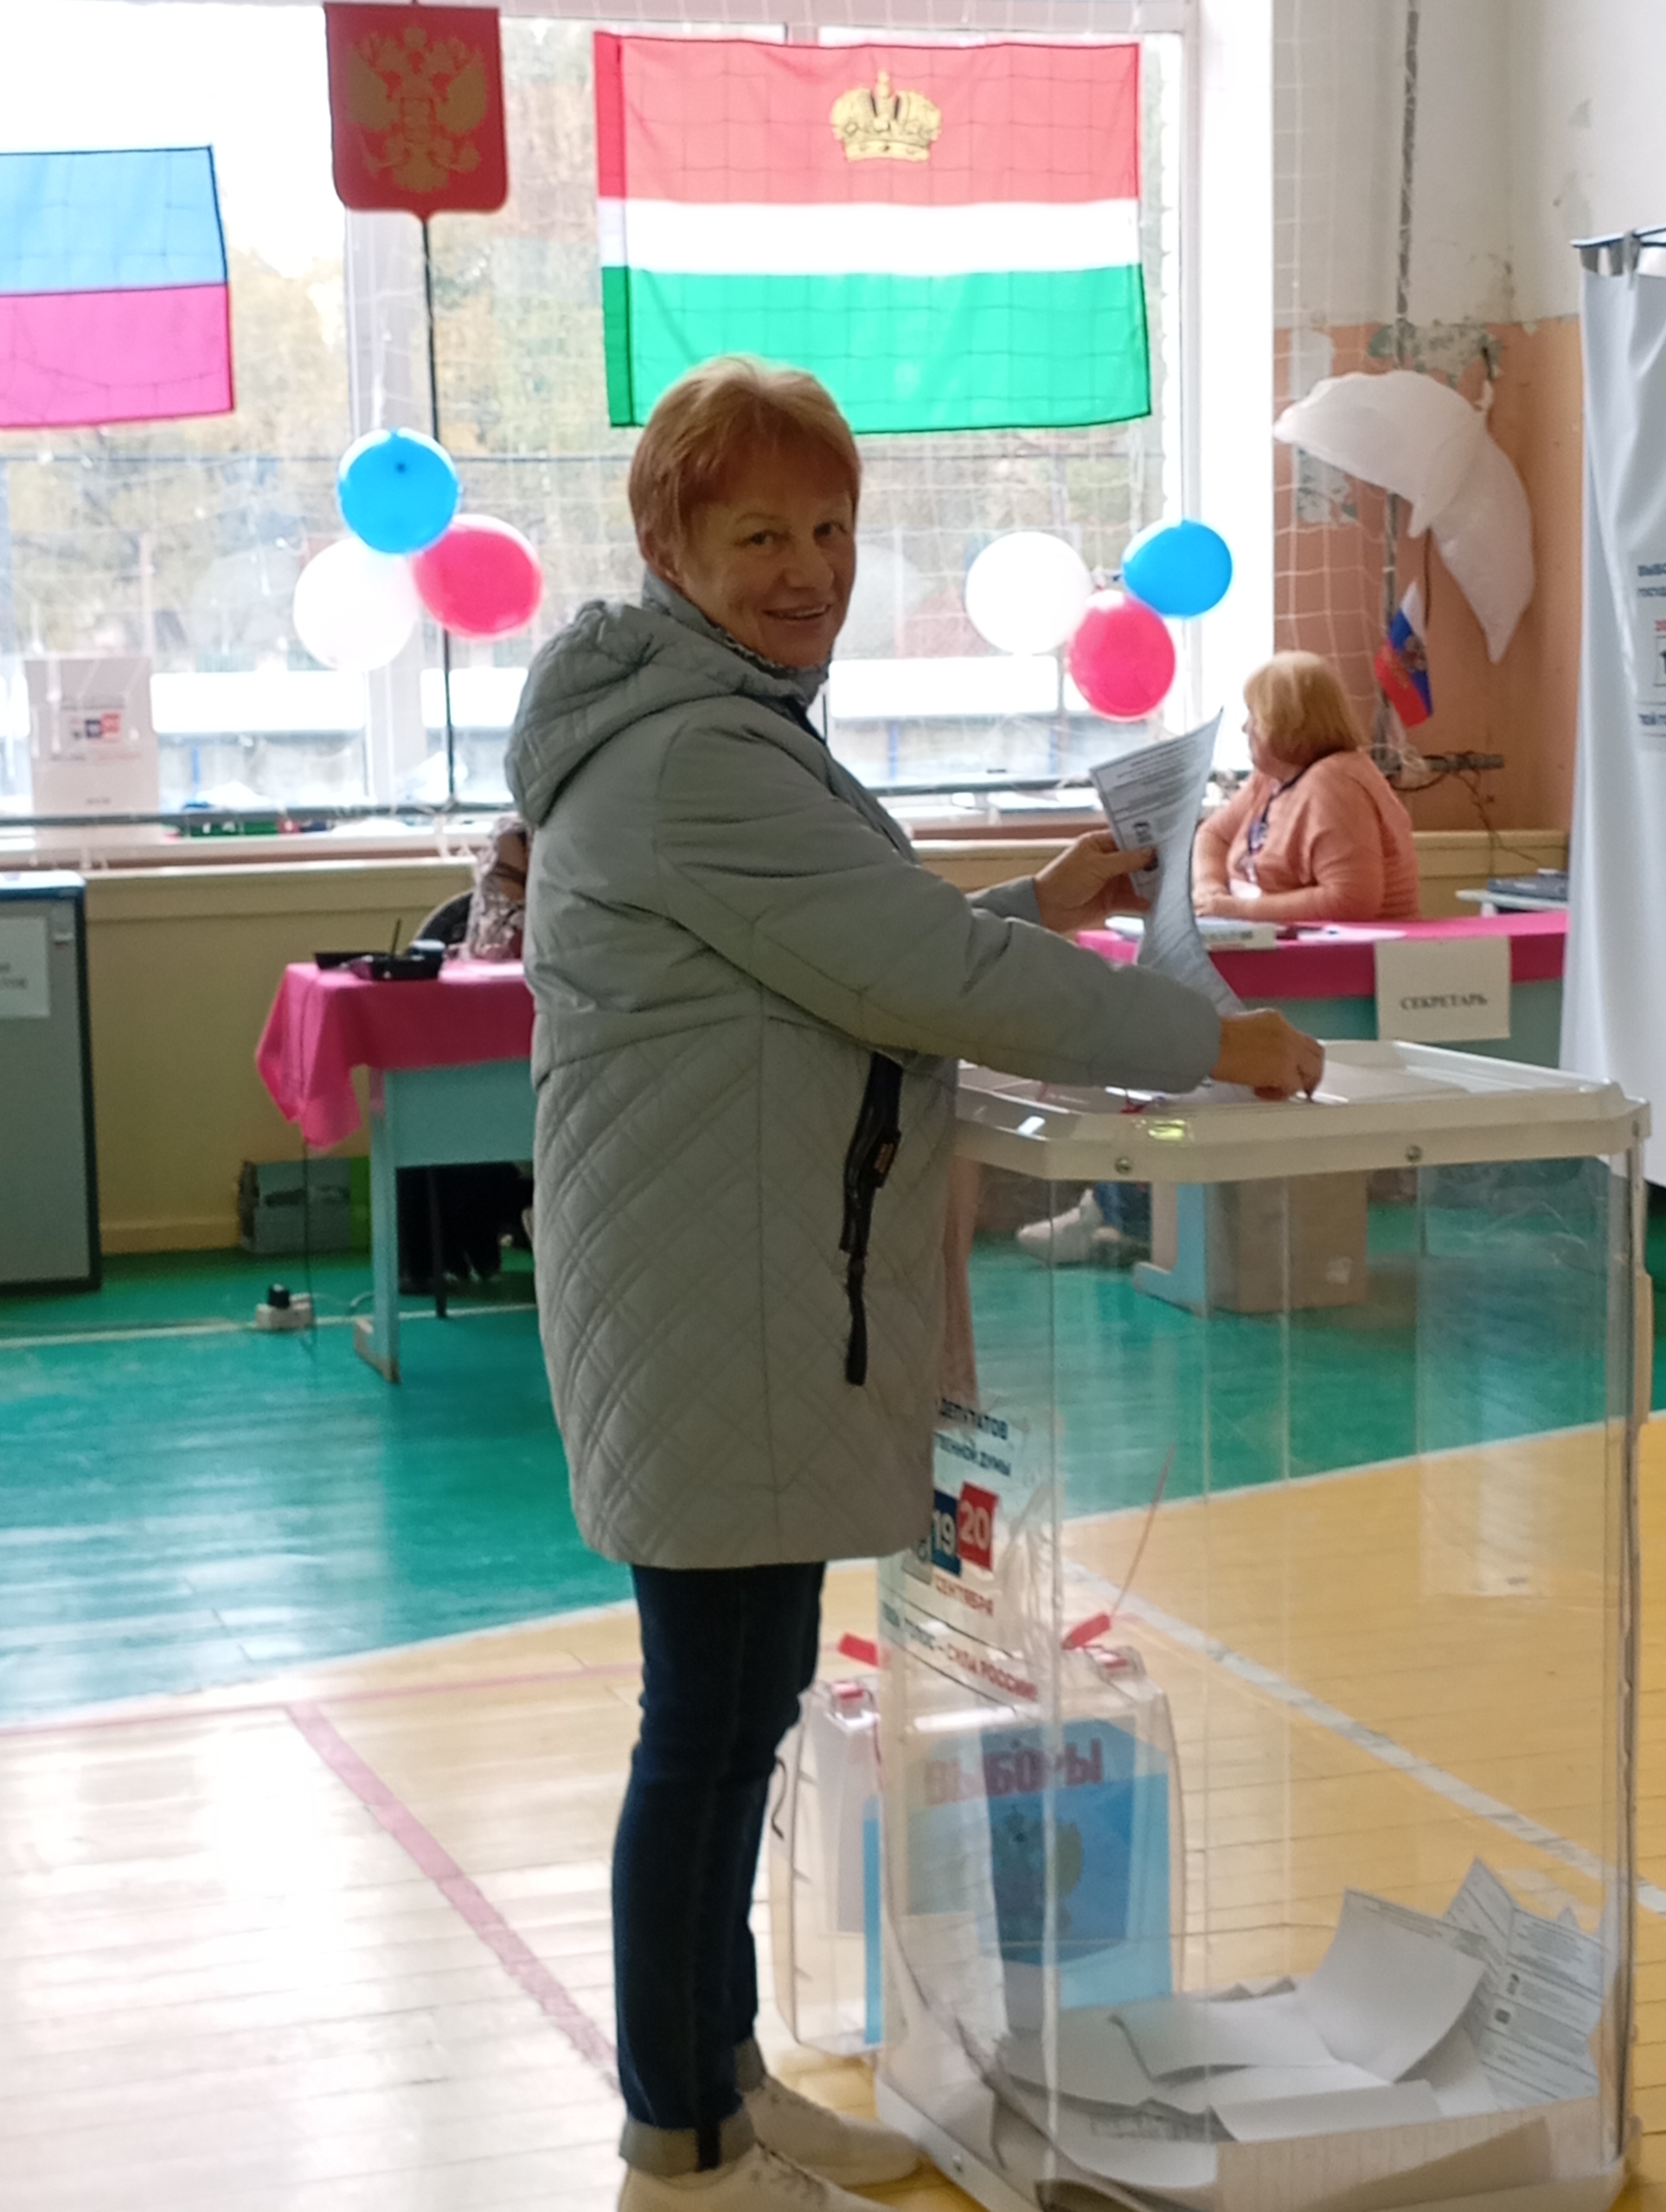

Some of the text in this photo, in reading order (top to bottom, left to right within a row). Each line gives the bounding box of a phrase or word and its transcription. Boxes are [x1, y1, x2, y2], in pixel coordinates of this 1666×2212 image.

[1400, 993, 1488, 1009] СЕКРЕТАРЬ
[932, 1509, 957, 1557] 19
[960, 1500, 992, 1551] 20
